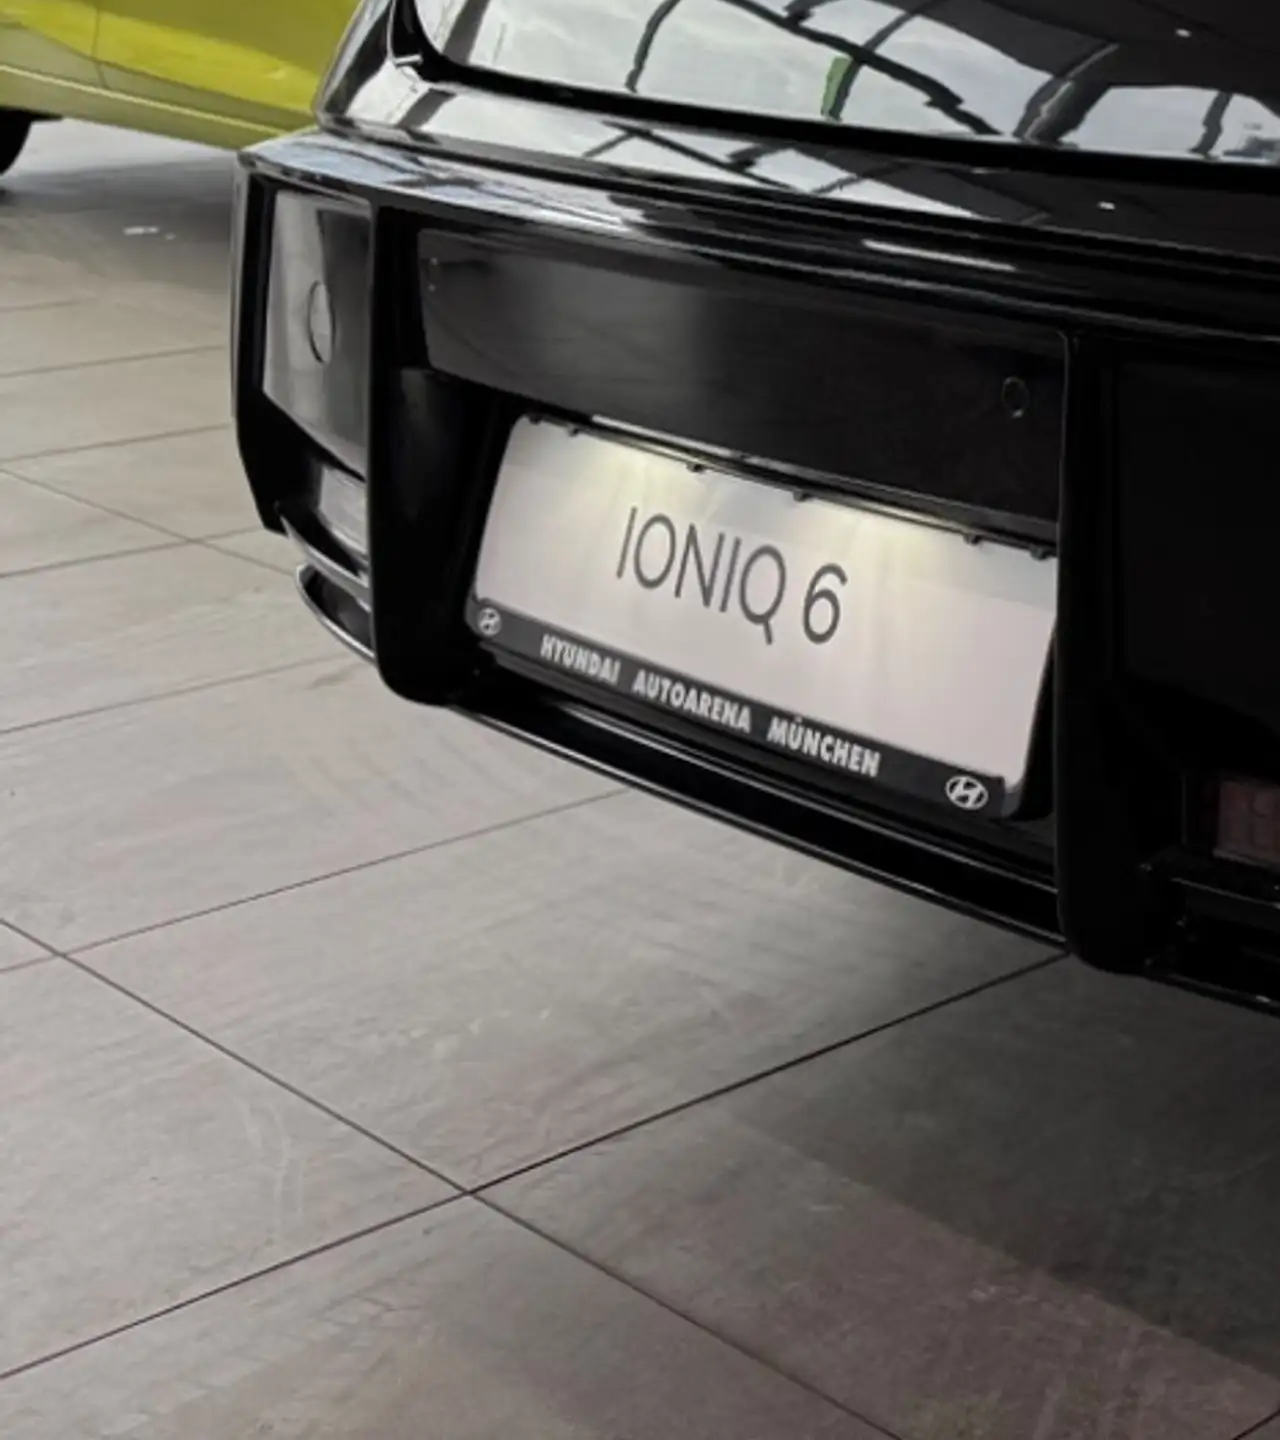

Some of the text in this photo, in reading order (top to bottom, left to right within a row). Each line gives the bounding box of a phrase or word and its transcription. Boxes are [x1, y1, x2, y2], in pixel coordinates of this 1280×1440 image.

[616, 506, 848, 645] IONIQ 6
[540, 633, 880, 778] HYUNDAI AUTOARENA MÜNCHEN
